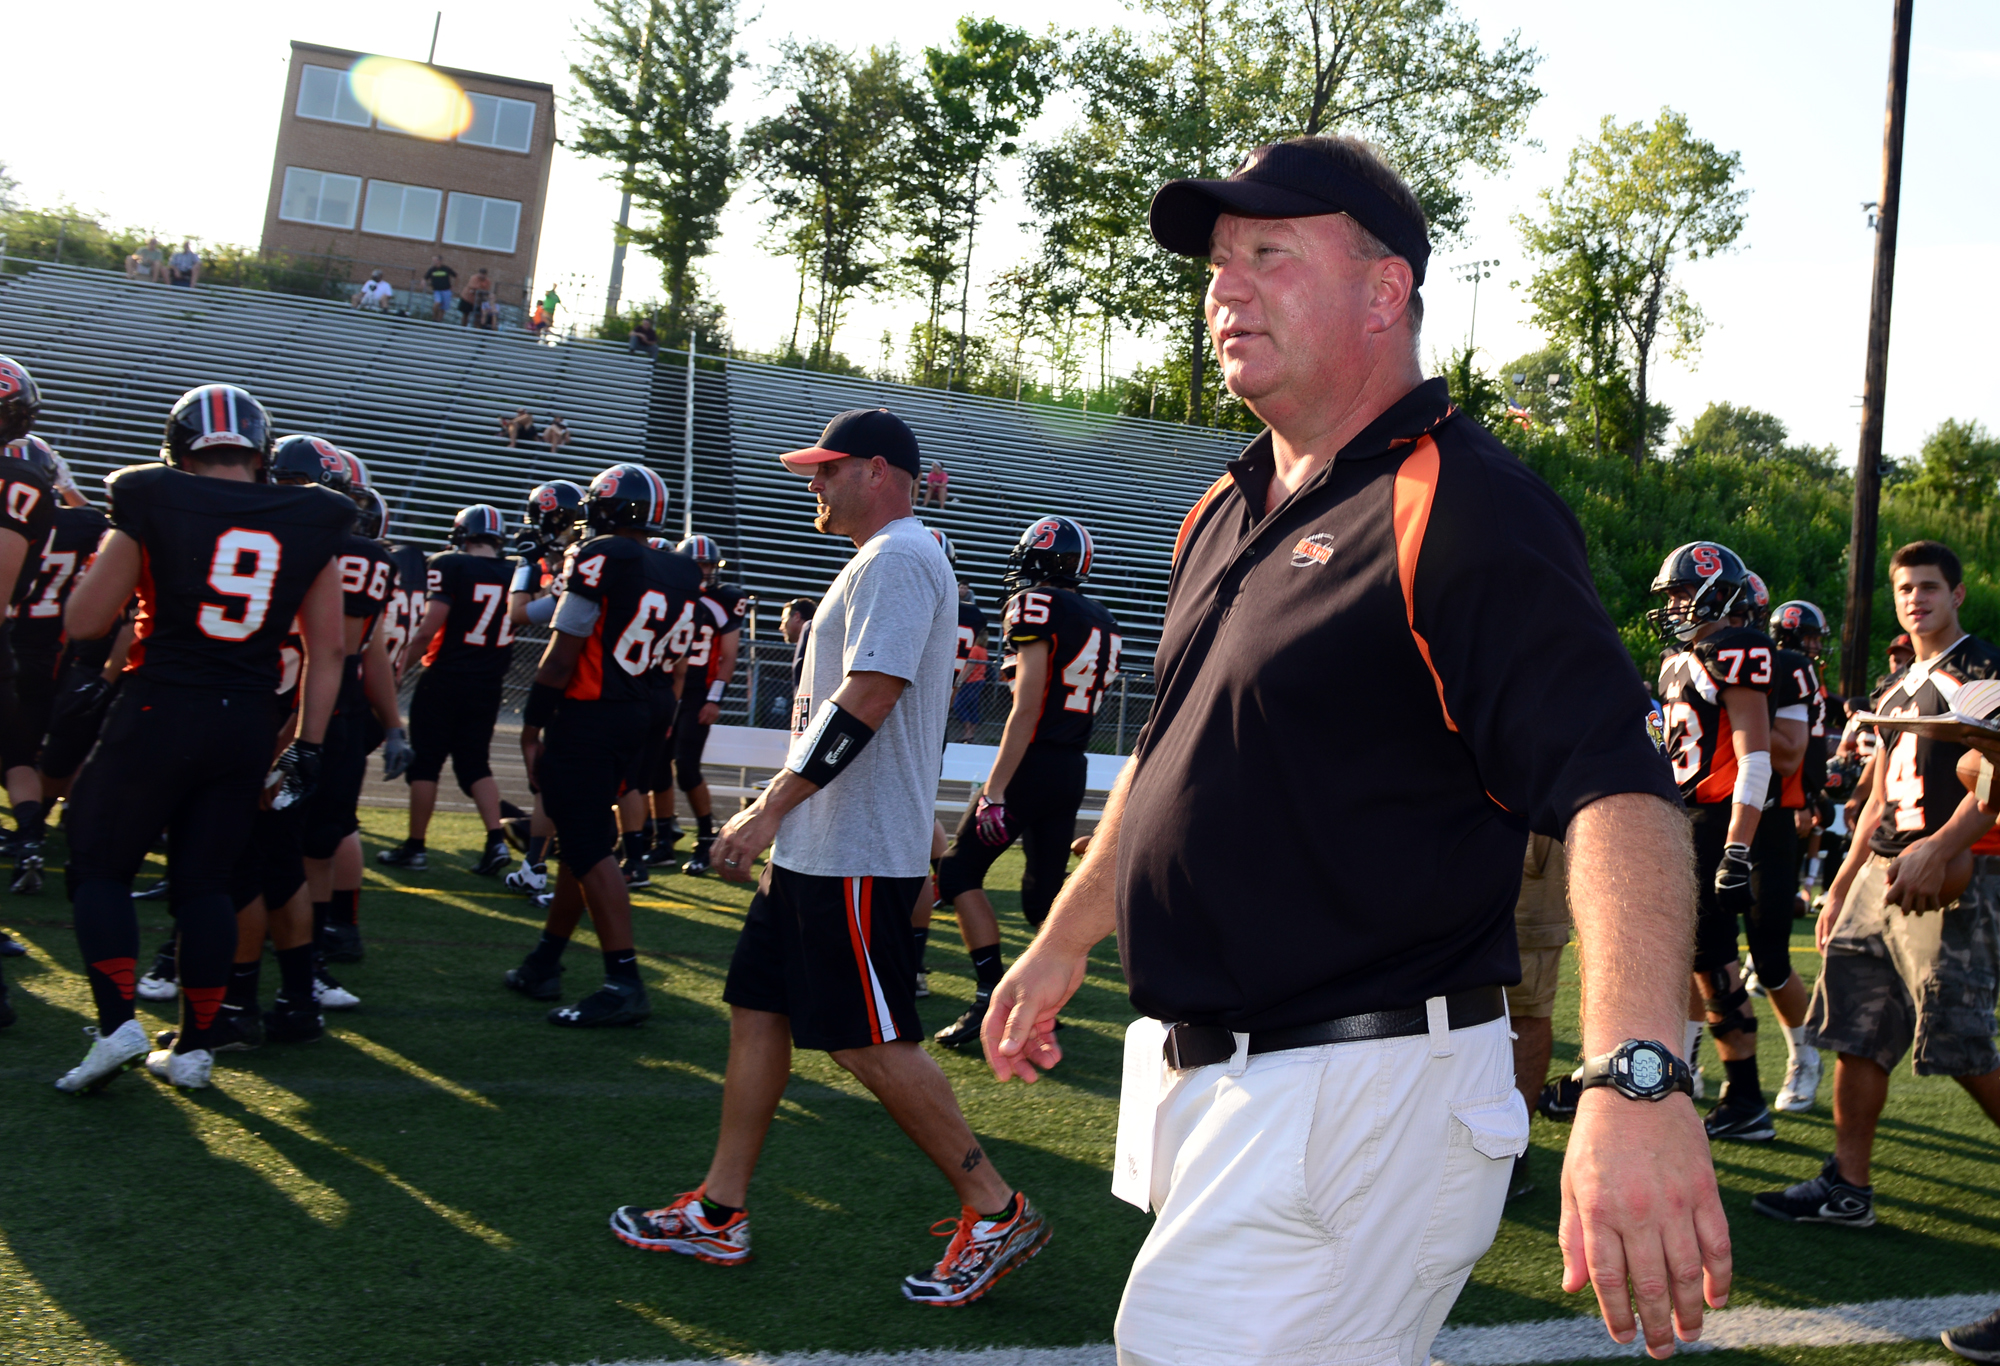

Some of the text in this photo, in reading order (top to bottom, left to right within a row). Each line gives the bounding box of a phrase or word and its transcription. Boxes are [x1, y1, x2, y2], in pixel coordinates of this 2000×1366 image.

[538, 487, 559, 512] S
[1032, 520, 1060, 549] S
[337, 554, 391, 601] 86
[1692, 545, 1723, 578] S
[196, 526, 283, 641] 9
[1005, 592, 1053, 625] 45
[1780, 606, 1803, 630] S
[1717, 646, 1773, 685] 73
[1884, 730, 1926, 832] 4
